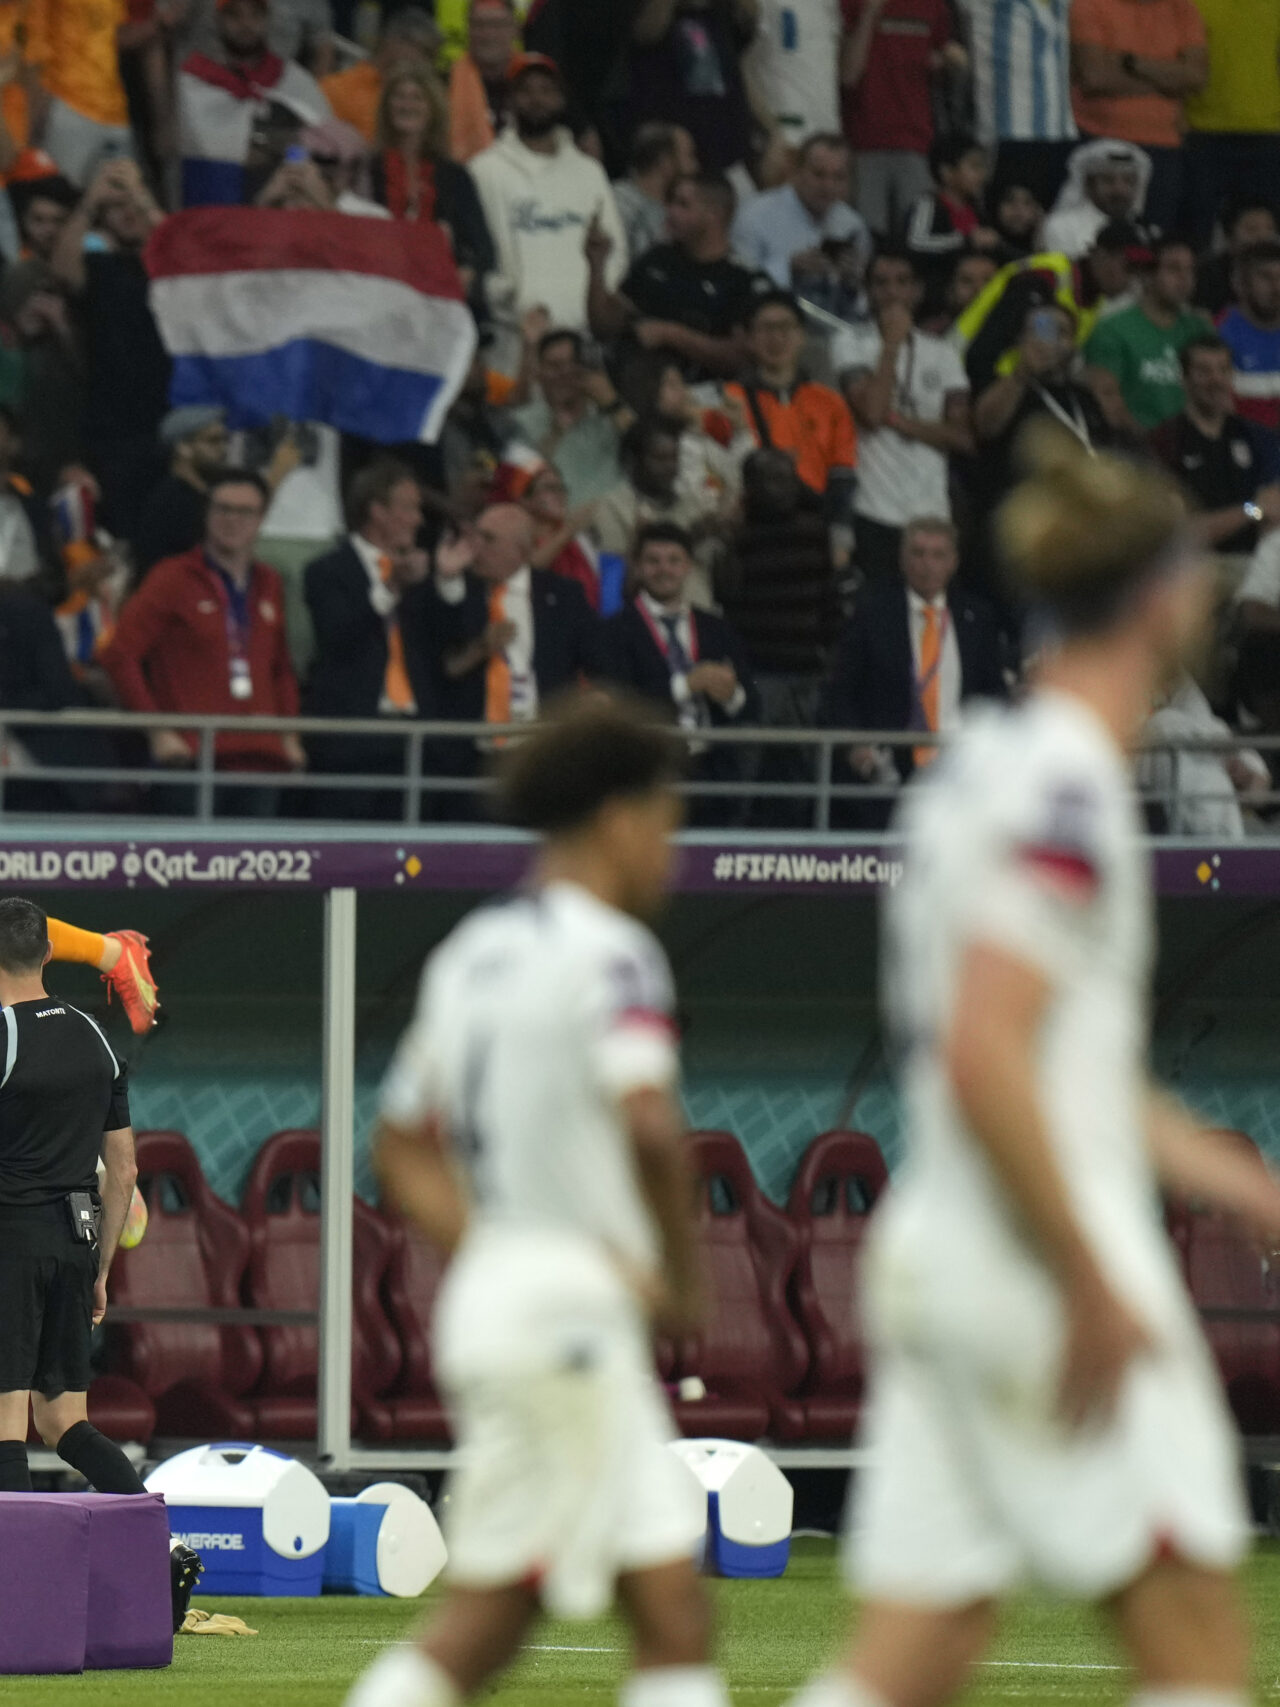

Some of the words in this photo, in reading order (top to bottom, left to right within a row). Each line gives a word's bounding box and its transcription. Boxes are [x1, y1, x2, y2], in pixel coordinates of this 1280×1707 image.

[64, 851, 118, 881] CUP
[713, 853, 904, 887] #FIFAWorldCup
[171, 1532, 242, 1550] WERADE
